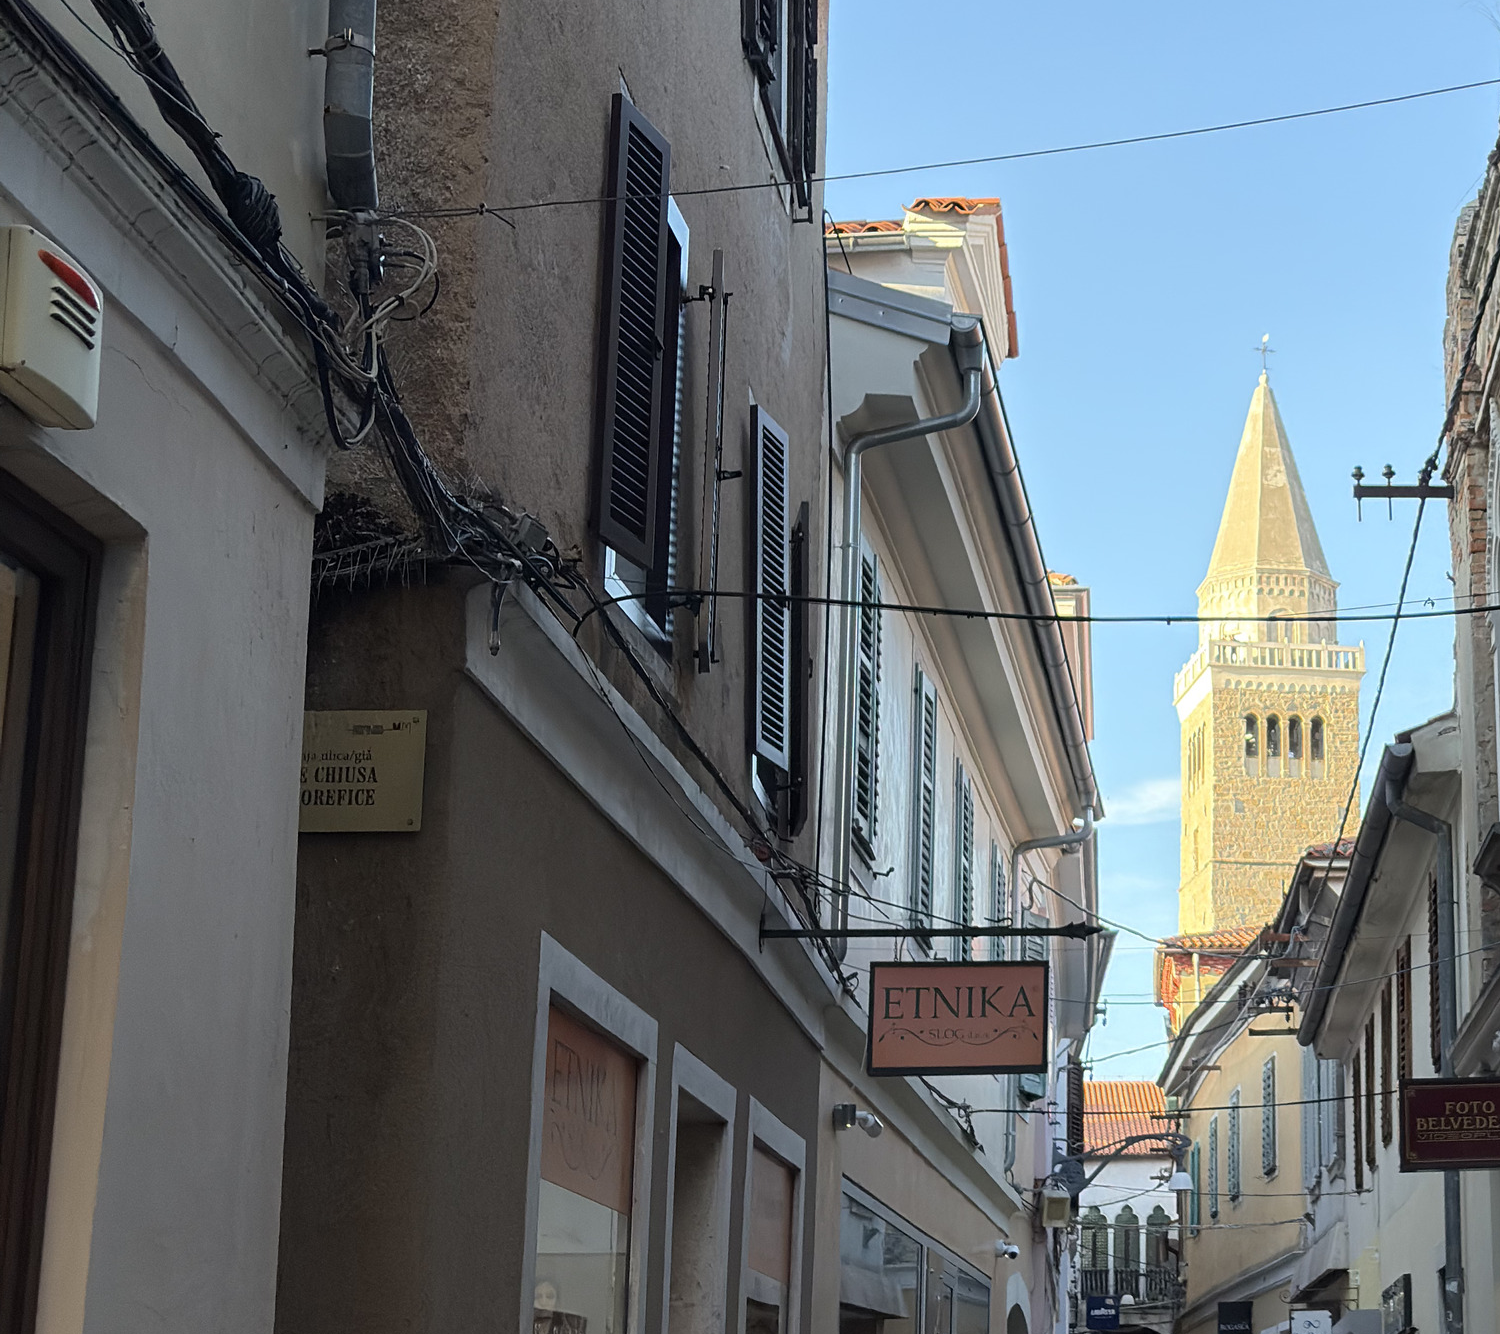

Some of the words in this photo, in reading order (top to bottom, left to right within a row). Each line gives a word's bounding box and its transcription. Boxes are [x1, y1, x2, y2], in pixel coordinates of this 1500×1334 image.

[314, 766, 379, 784] CHIUSA
[301, 788, 376, 806] OREFICE
[882, 985, 1036, 1020] ETNIKA
[1444, 1100, 1496, 1115] FOTO
